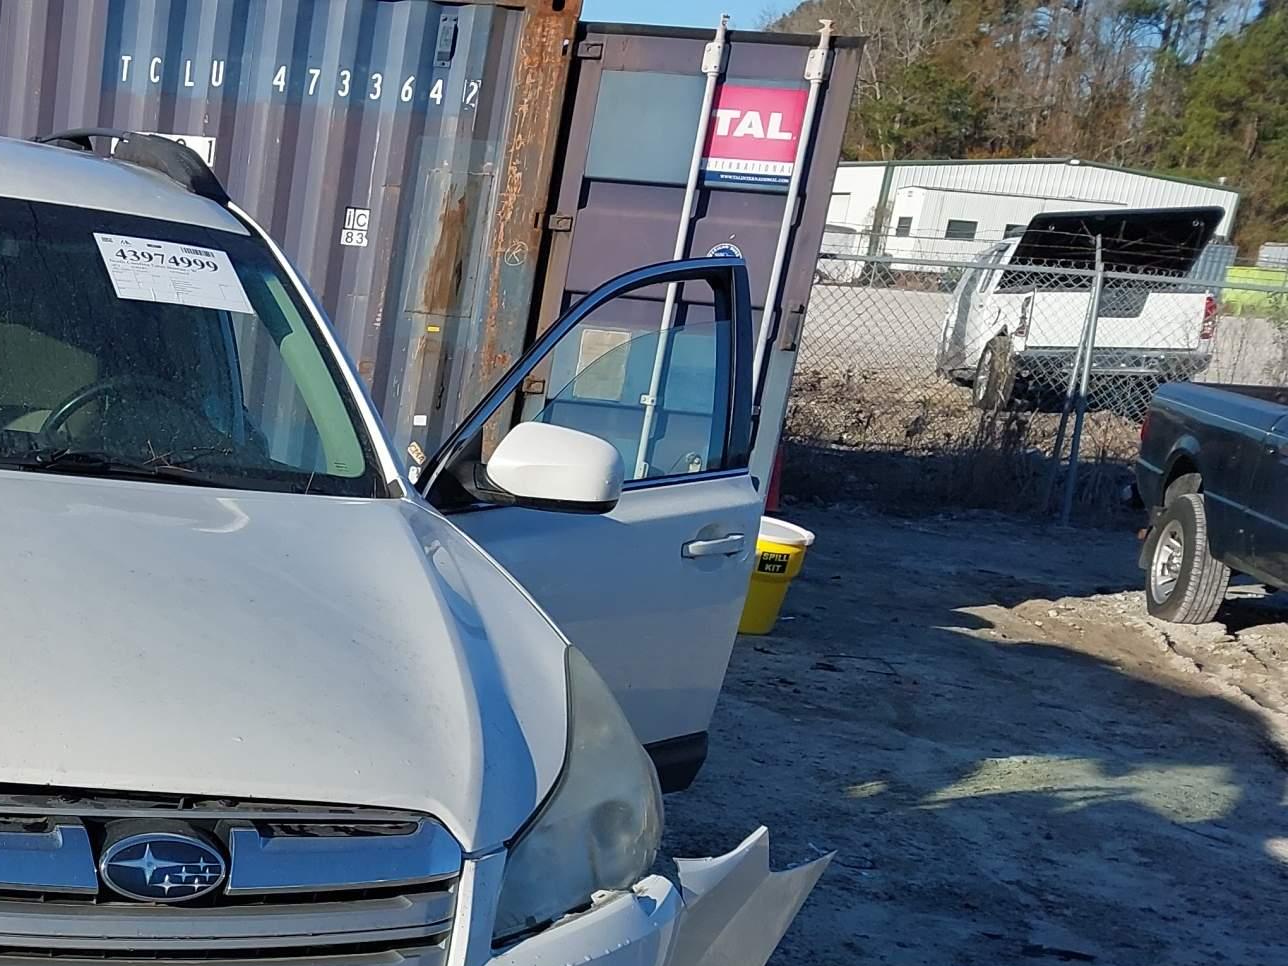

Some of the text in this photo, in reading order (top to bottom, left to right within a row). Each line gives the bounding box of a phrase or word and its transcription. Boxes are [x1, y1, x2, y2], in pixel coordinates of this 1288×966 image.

[120, 55, 224, 88] TCLU
[712, 109, 792, 140] TAL
[345, 231, 364, 244] 83
[115, 248, 218, 272] 43974999
[763, 552, 788, 561] SPILL
[765, 563, 782, 572] KIT
